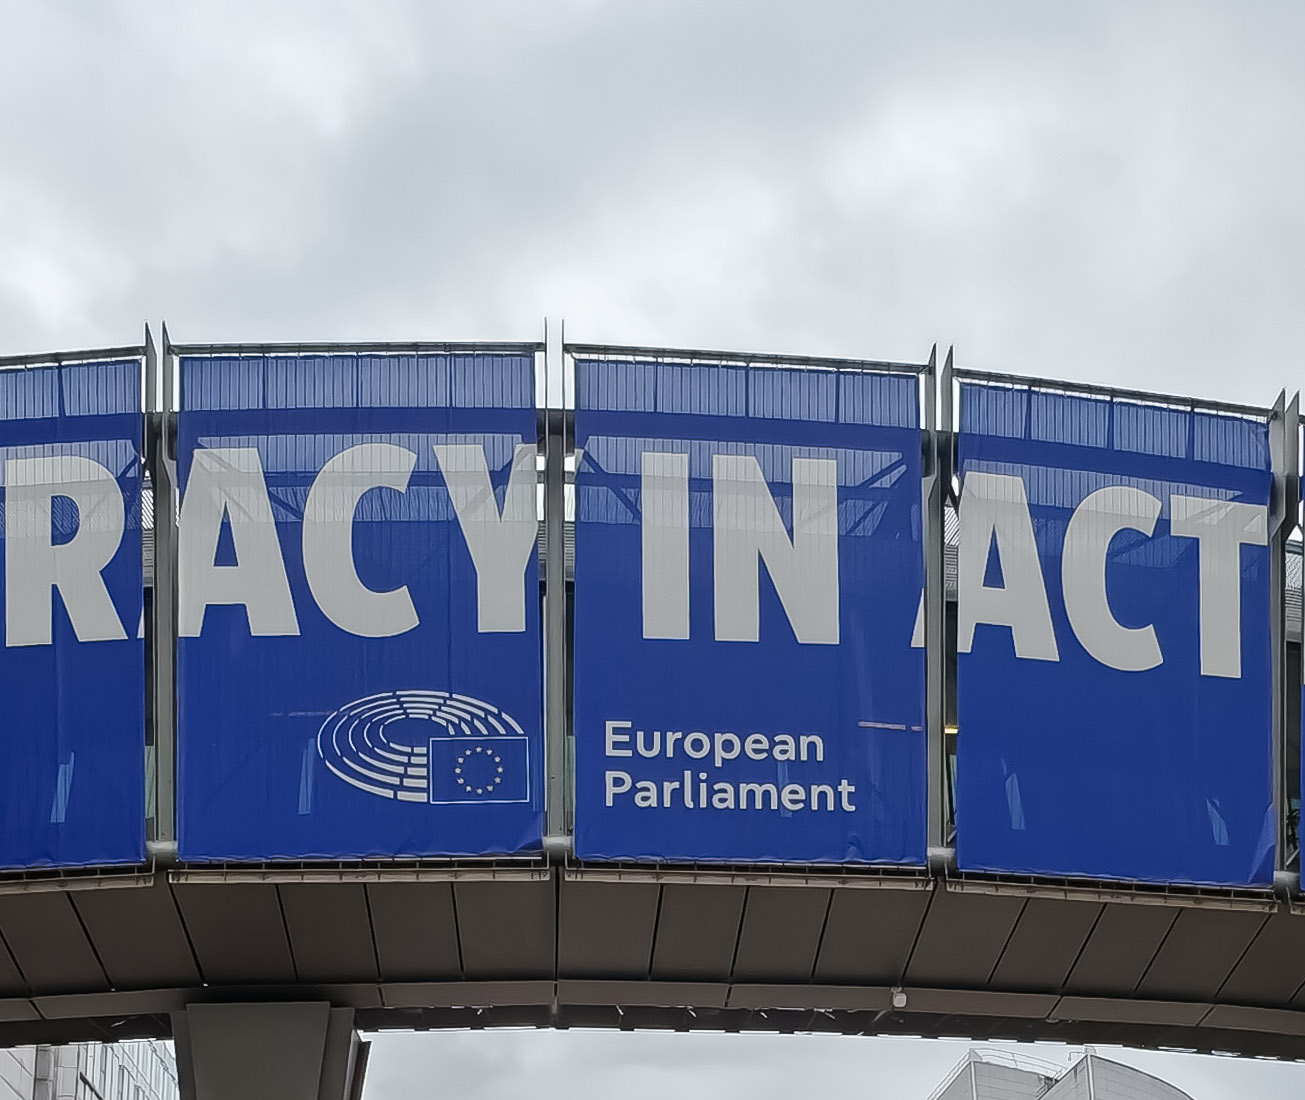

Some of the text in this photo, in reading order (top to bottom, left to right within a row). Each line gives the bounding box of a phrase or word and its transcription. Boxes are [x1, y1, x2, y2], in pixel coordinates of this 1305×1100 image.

[641, 451, 841, 646] IN
[604, 720, 825, 768] European
[604, 770, 857, 812] Parliament
